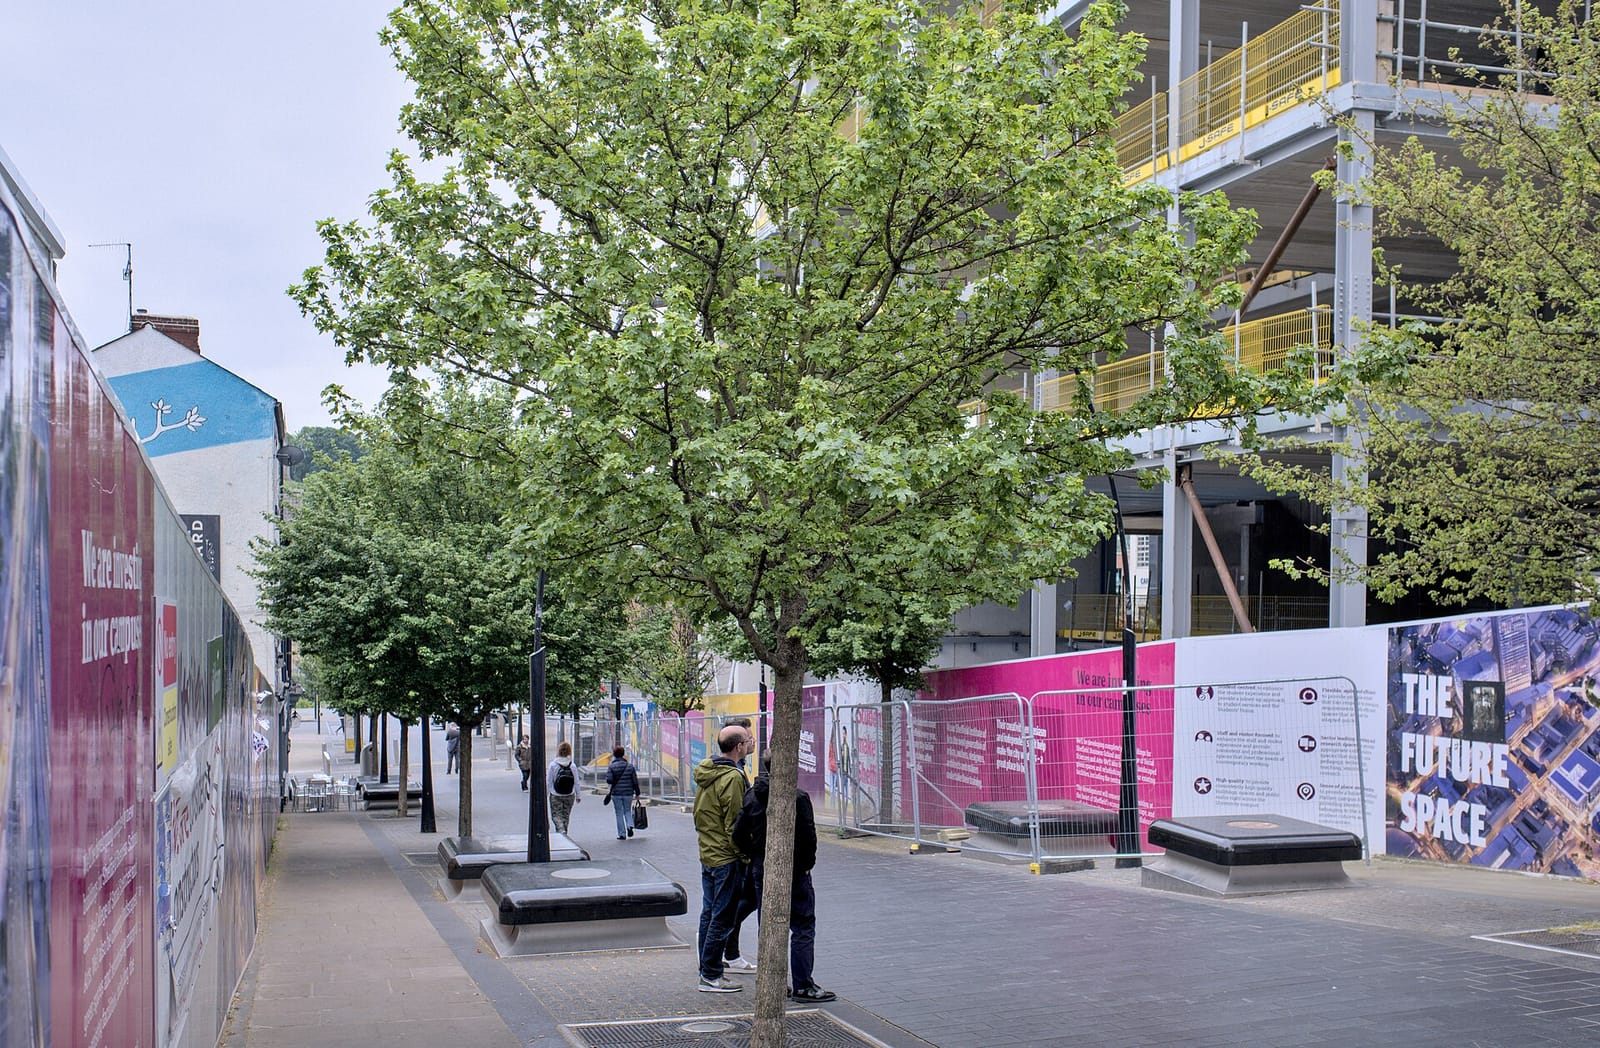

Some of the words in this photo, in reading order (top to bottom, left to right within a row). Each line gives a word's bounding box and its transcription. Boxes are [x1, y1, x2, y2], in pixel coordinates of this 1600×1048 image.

[1198, 123, 1234, 149] J-SAFE
[82, 529, 97, 588] We
[98, 547, 112, 589] are
[82, 602, 93, 664] in
[94, 618, 109, 661] our
[1077, 670, 1090, 685] We
[1091, 674, 1106, 687] are
[1107, 672, 1152, 696] inving
[1087, 695, 1102, 708] our
[1104, 697, 1152, 715] camses
[1402, 673, 1453, 718] THE
[1401, 732, 1510, 788] FUTURE
[1400, 791, 1487, 848] SPACE
